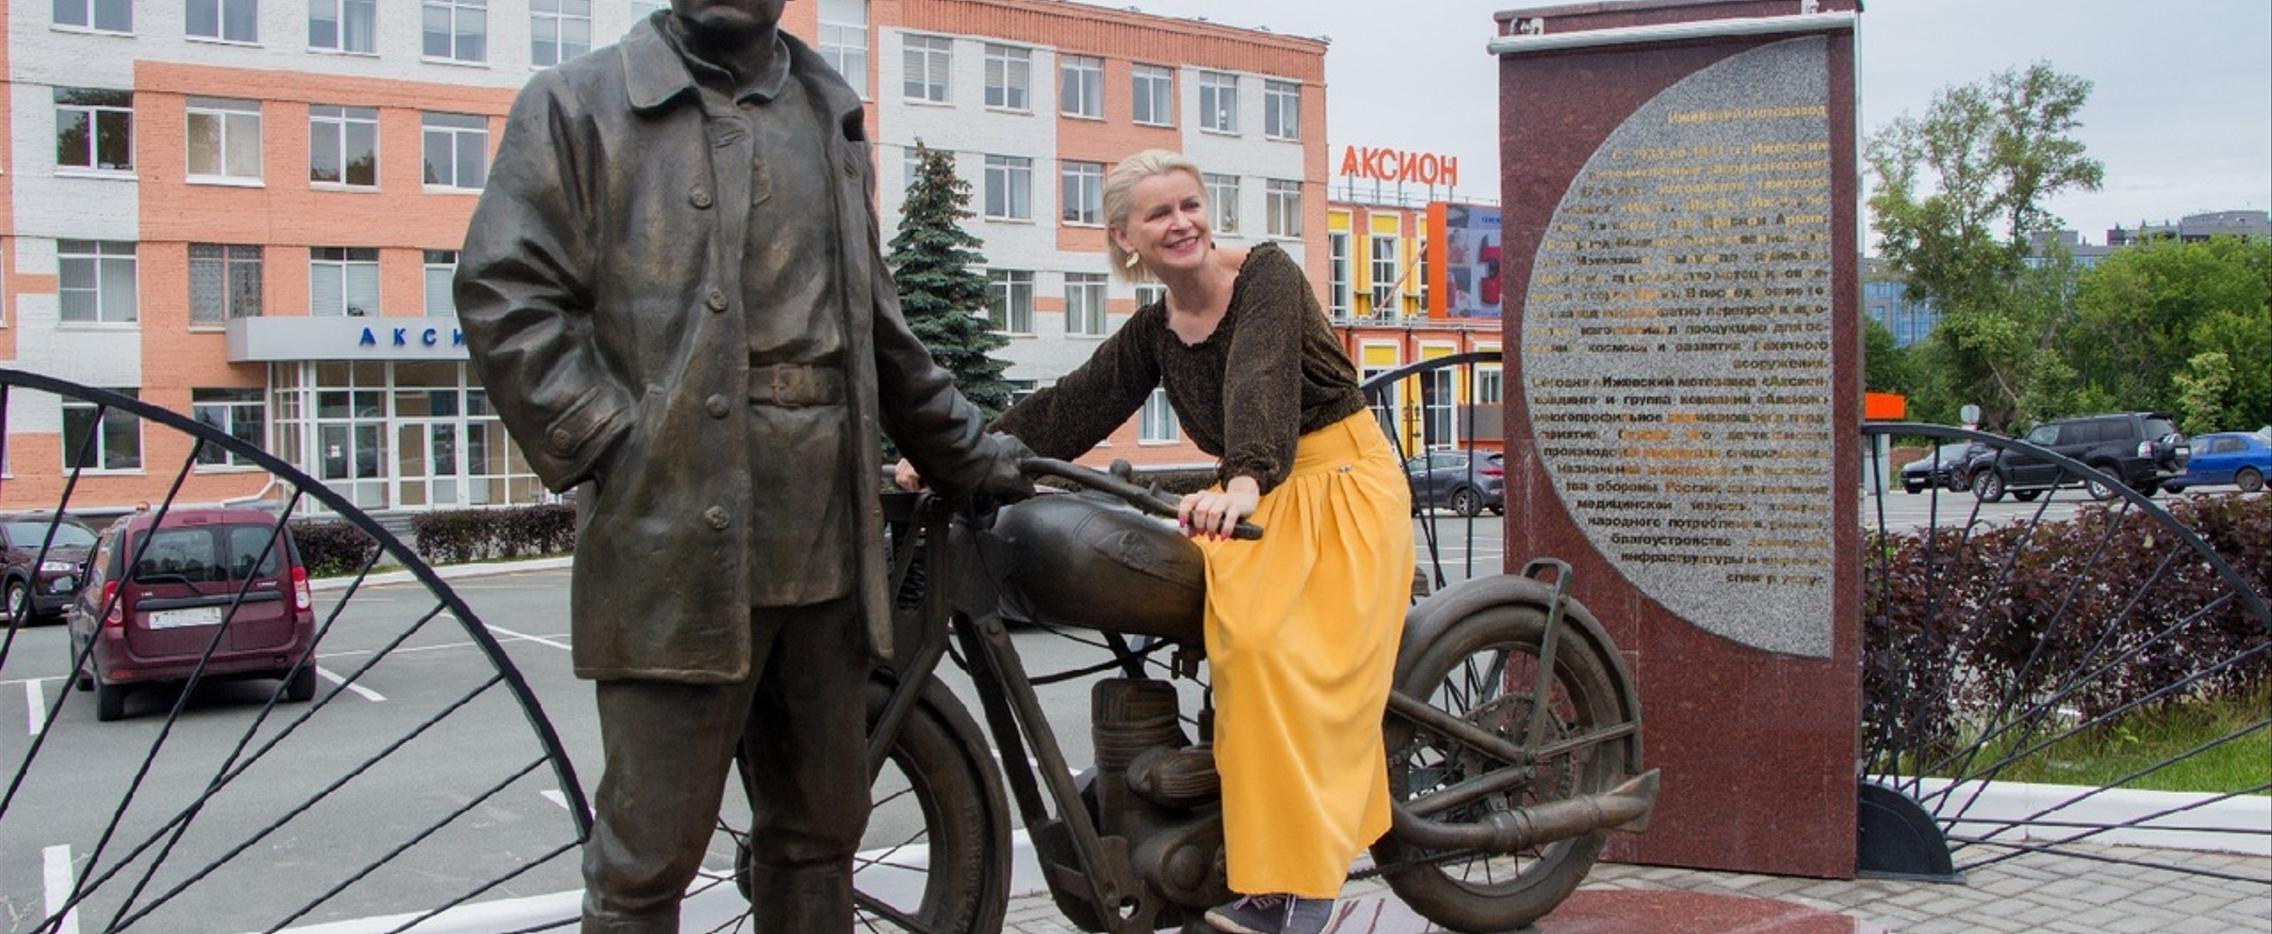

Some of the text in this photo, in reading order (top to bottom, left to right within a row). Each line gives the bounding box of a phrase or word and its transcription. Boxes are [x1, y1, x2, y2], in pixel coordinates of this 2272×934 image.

[1340, 145, 1458, 186] АКСИОН
[1686, 321, 1767, 335] продукцию
[1657, 342, 1665, 353] и
[1605, 395, 1615, 405] и
[1623, 394, 1672, 406] группа
[1596, 480, 1658, 494] обороны
[1587, 517, 1662, 528] народного
